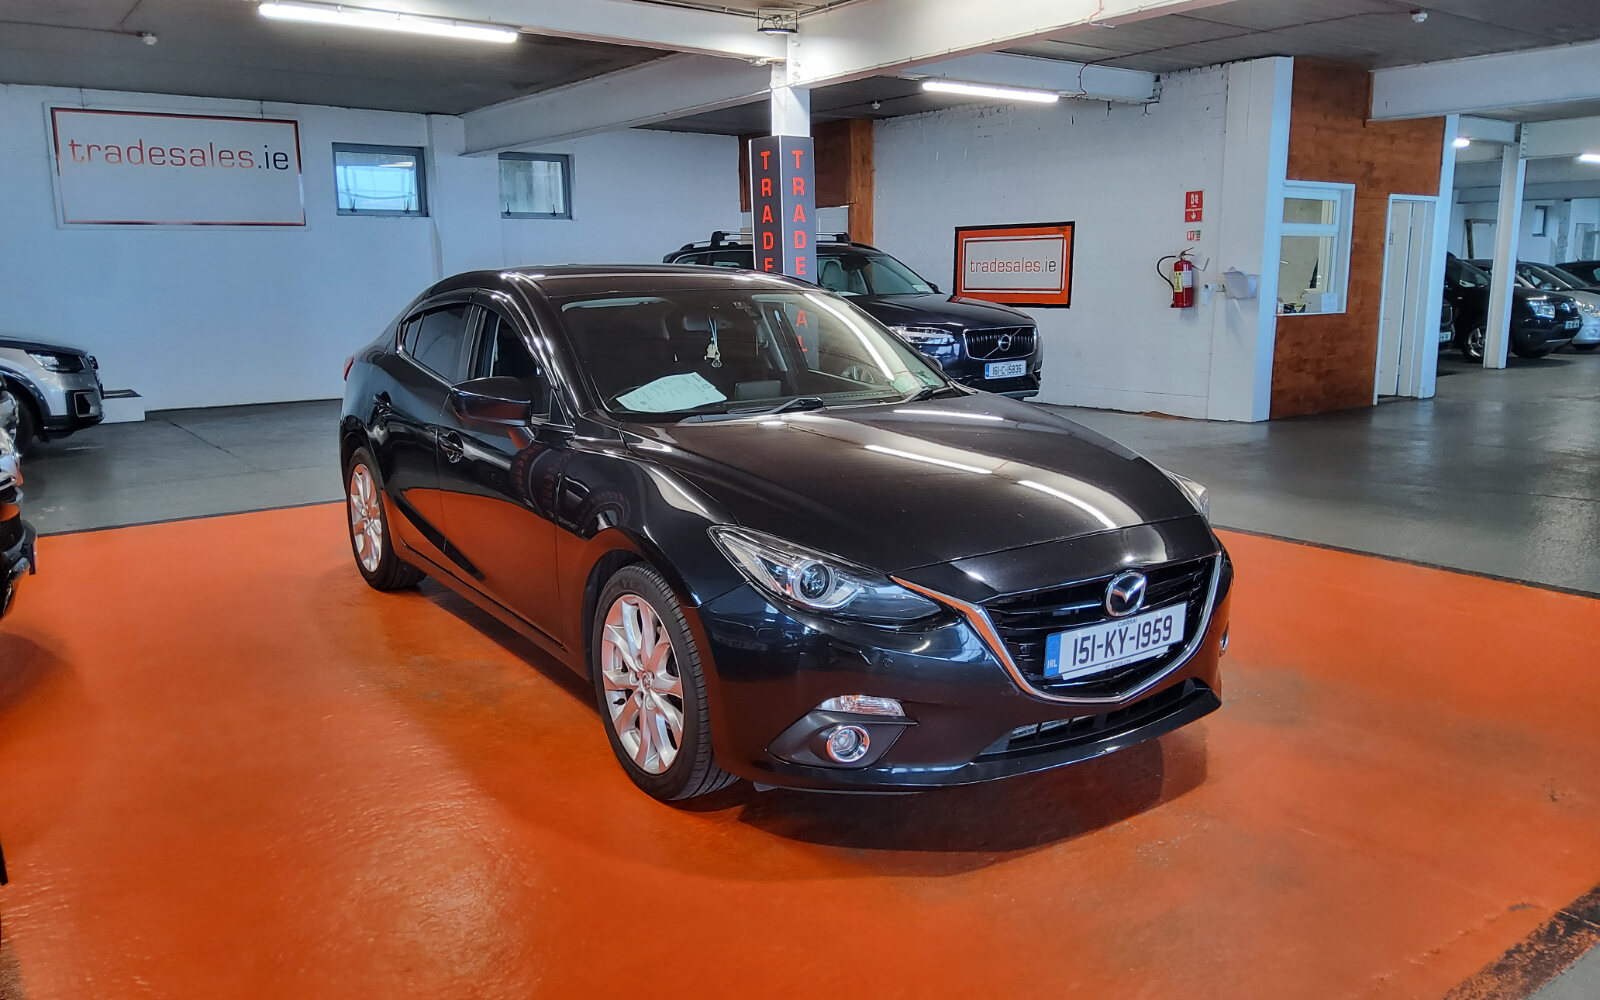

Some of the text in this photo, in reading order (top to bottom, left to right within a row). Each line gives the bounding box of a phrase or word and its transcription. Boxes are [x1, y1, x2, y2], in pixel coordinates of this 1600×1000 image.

[68, 138, 290, 171] tradesales.ie
[791, 149, 807, 276] TRADE
[969, 256, 1057, 273] tradesales.ie
[1047, 614, 1173, 669] IRL 151-KY-1959
